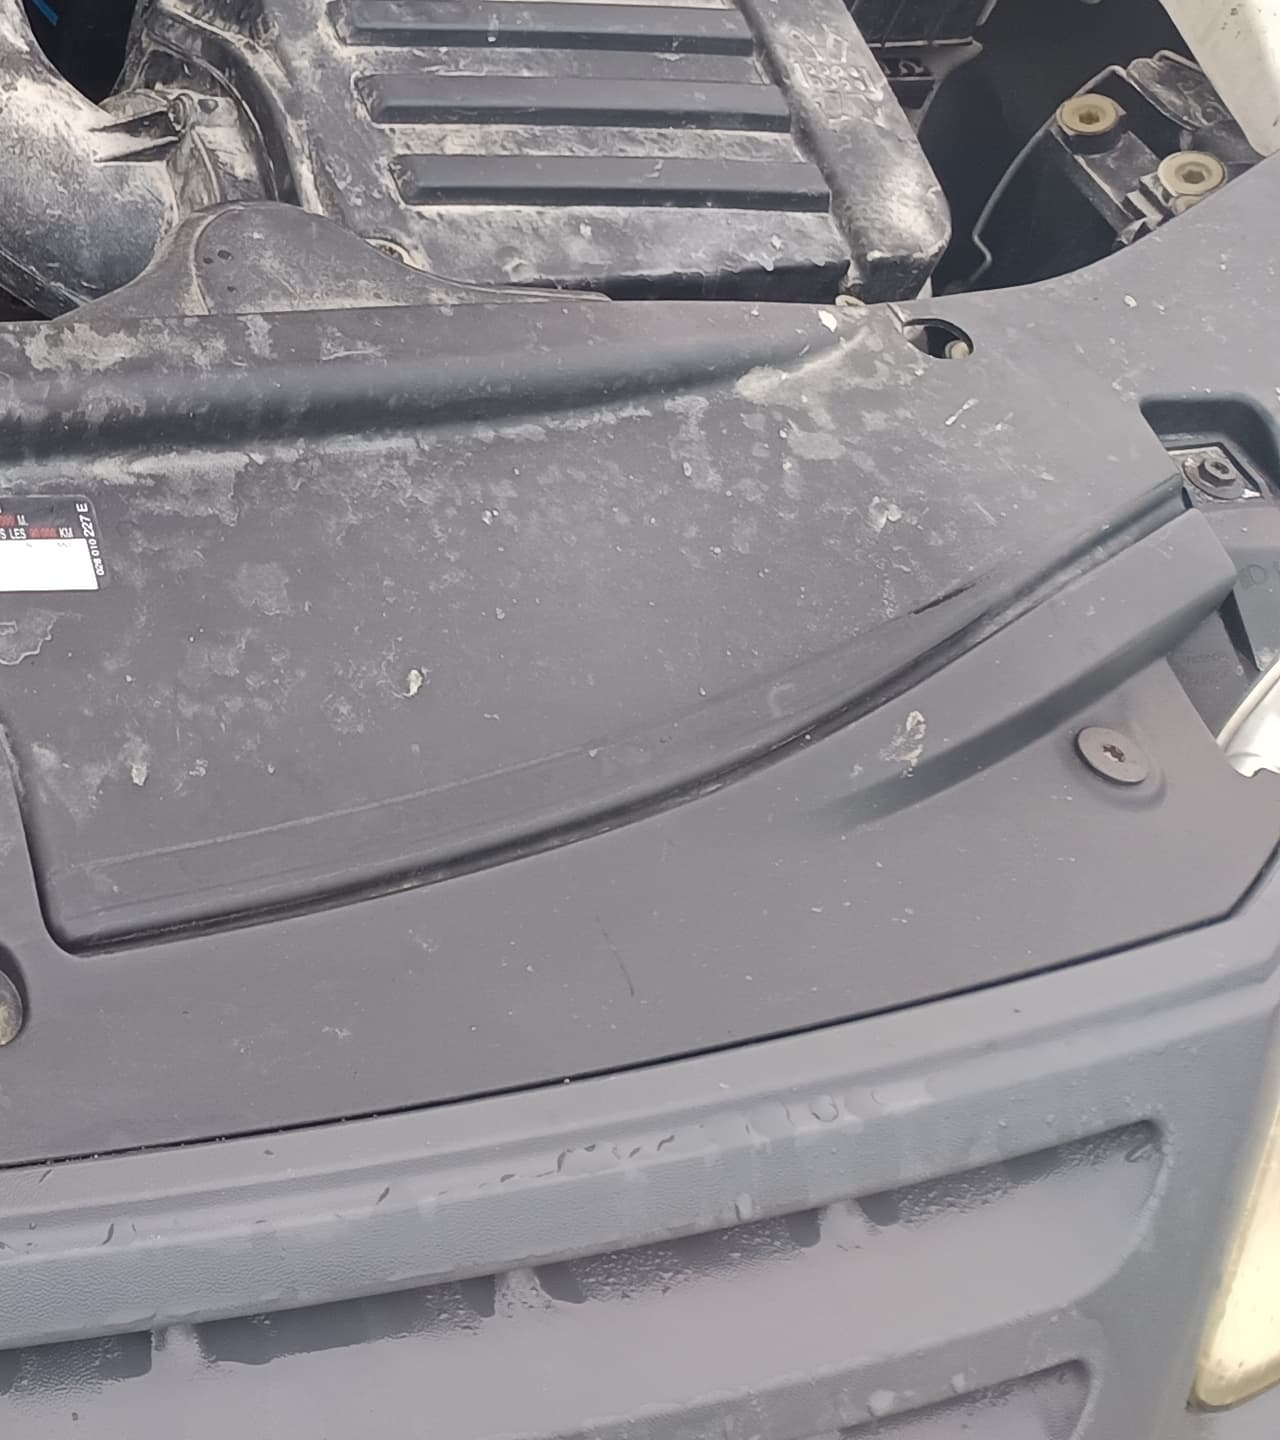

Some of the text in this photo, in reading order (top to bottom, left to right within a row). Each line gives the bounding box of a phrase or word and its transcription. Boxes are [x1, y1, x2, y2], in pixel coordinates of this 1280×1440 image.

[76, 503, 88, 513] E
[9, 528, 27, 539] LES
[58, 527, 73, 538] KM
[79, 514, 95, 538] 227
[88, 538, 100, 557] 010
